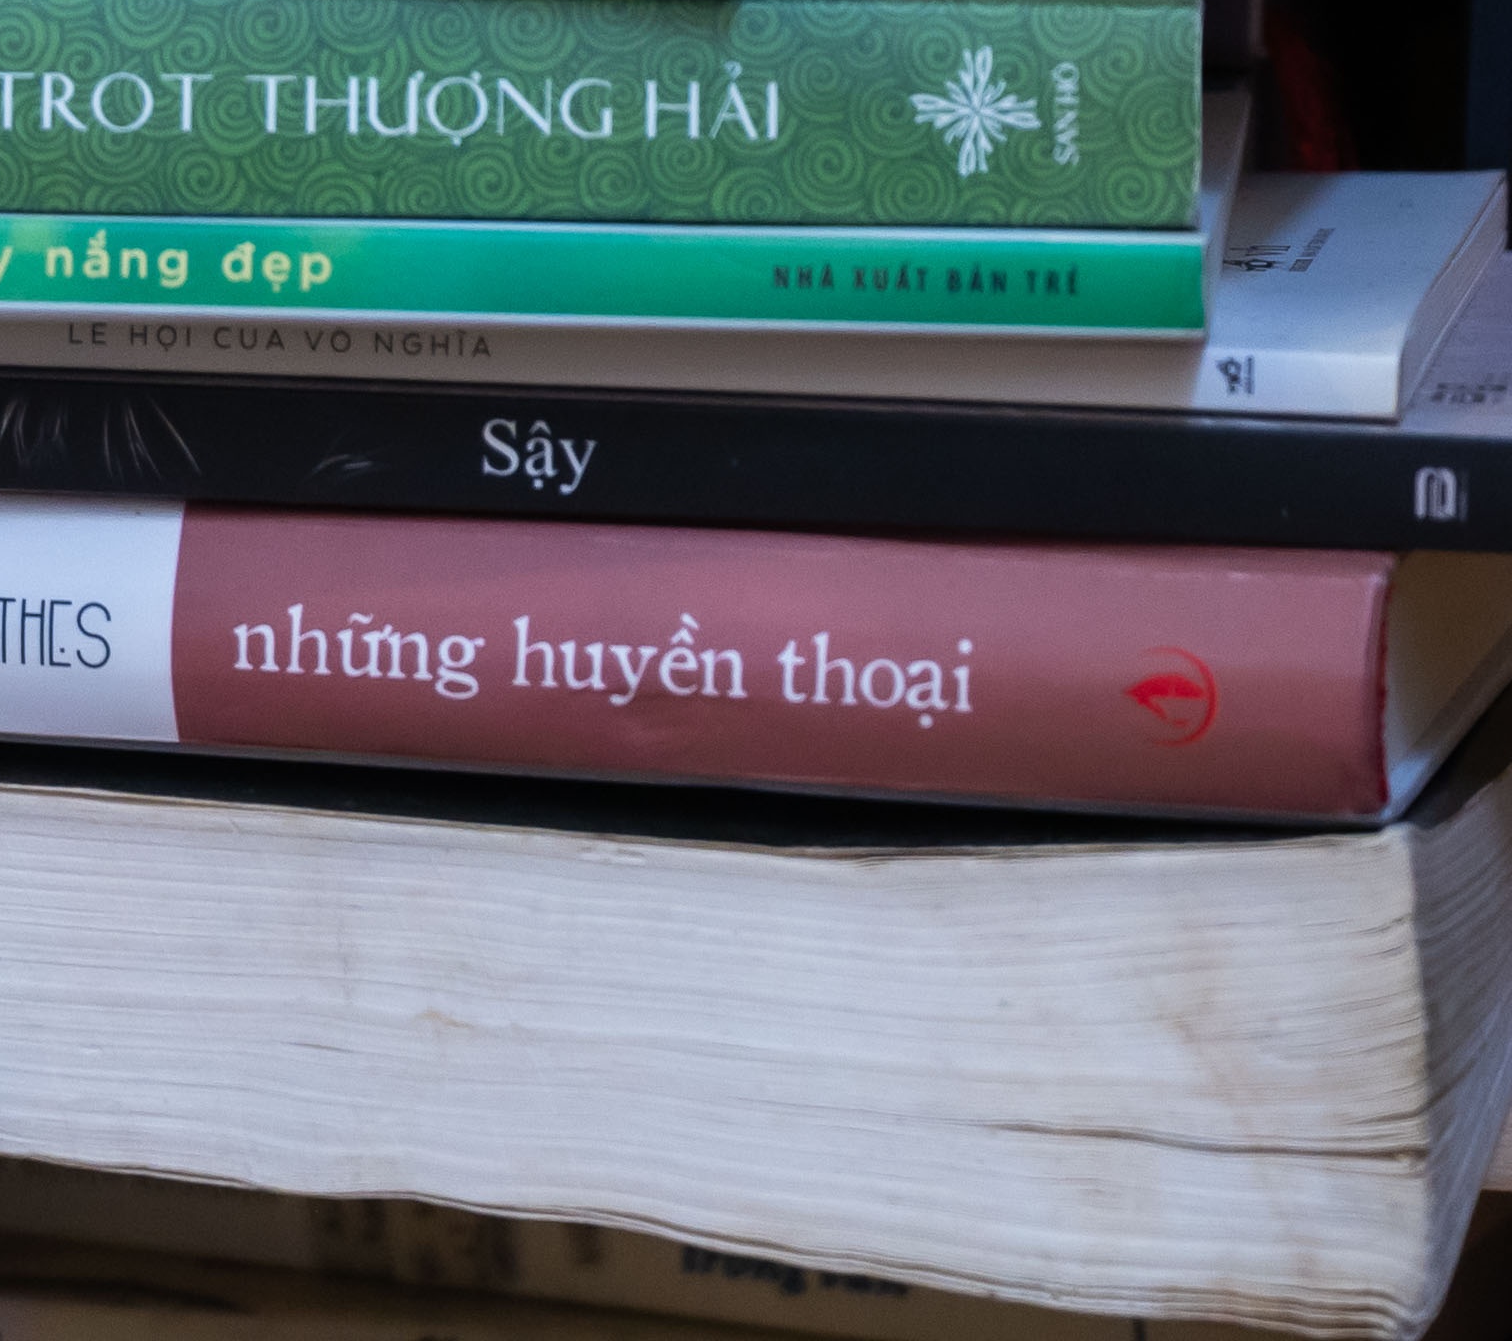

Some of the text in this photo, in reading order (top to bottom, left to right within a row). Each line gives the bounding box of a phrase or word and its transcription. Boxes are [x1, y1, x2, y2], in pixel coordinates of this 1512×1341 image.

[245, 71, 615, 147] THƯỢNG
[644, 58, 779, 142] HẢI
[44, 229, 190, 287] nắng
[219, 238, 334, 292] đẹp
[773, 261, 834, 290] NHÀ
[481, 419, 598, 495] Sậy
[233, 603, 974, 728] những huyền thoại
